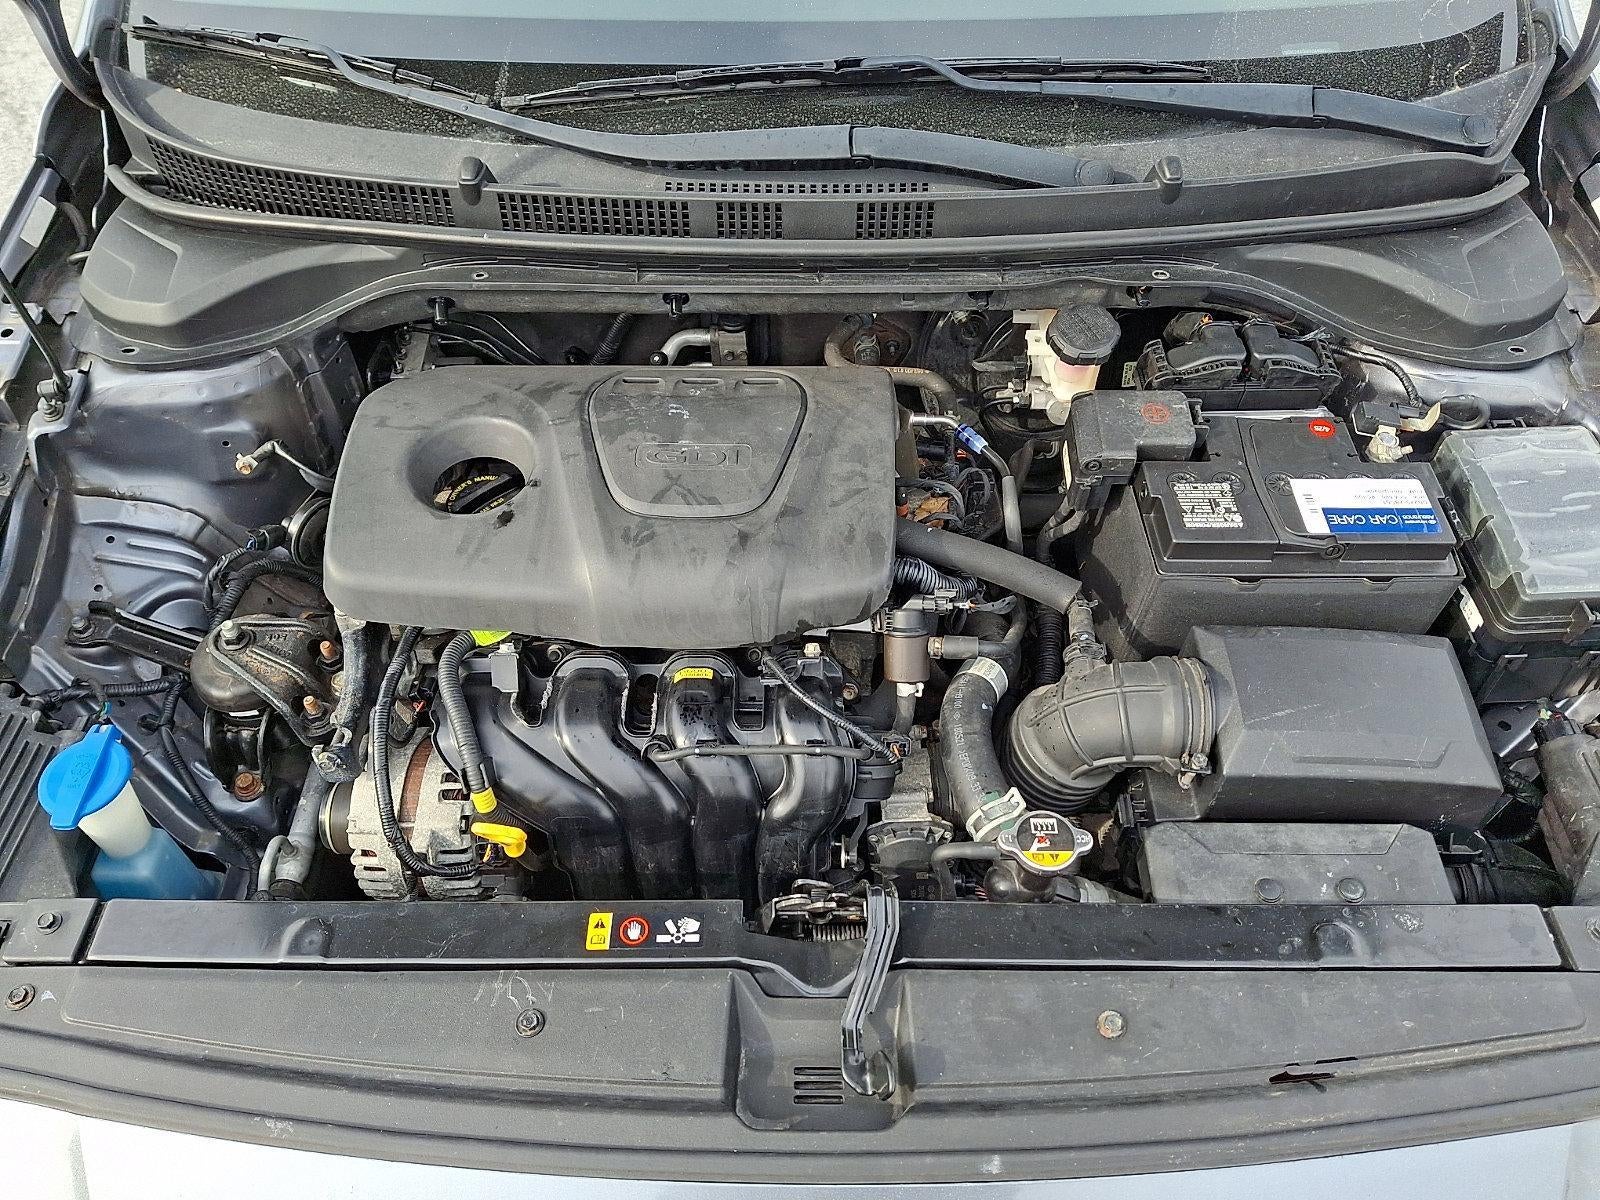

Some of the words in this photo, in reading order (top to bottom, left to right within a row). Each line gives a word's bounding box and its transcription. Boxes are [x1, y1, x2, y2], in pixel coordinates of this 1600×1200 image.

[645, 450, 739, 466] GDI
[1327, 514, 1366, 525] CARE
[1368, 514, 1398, 525] CAR
